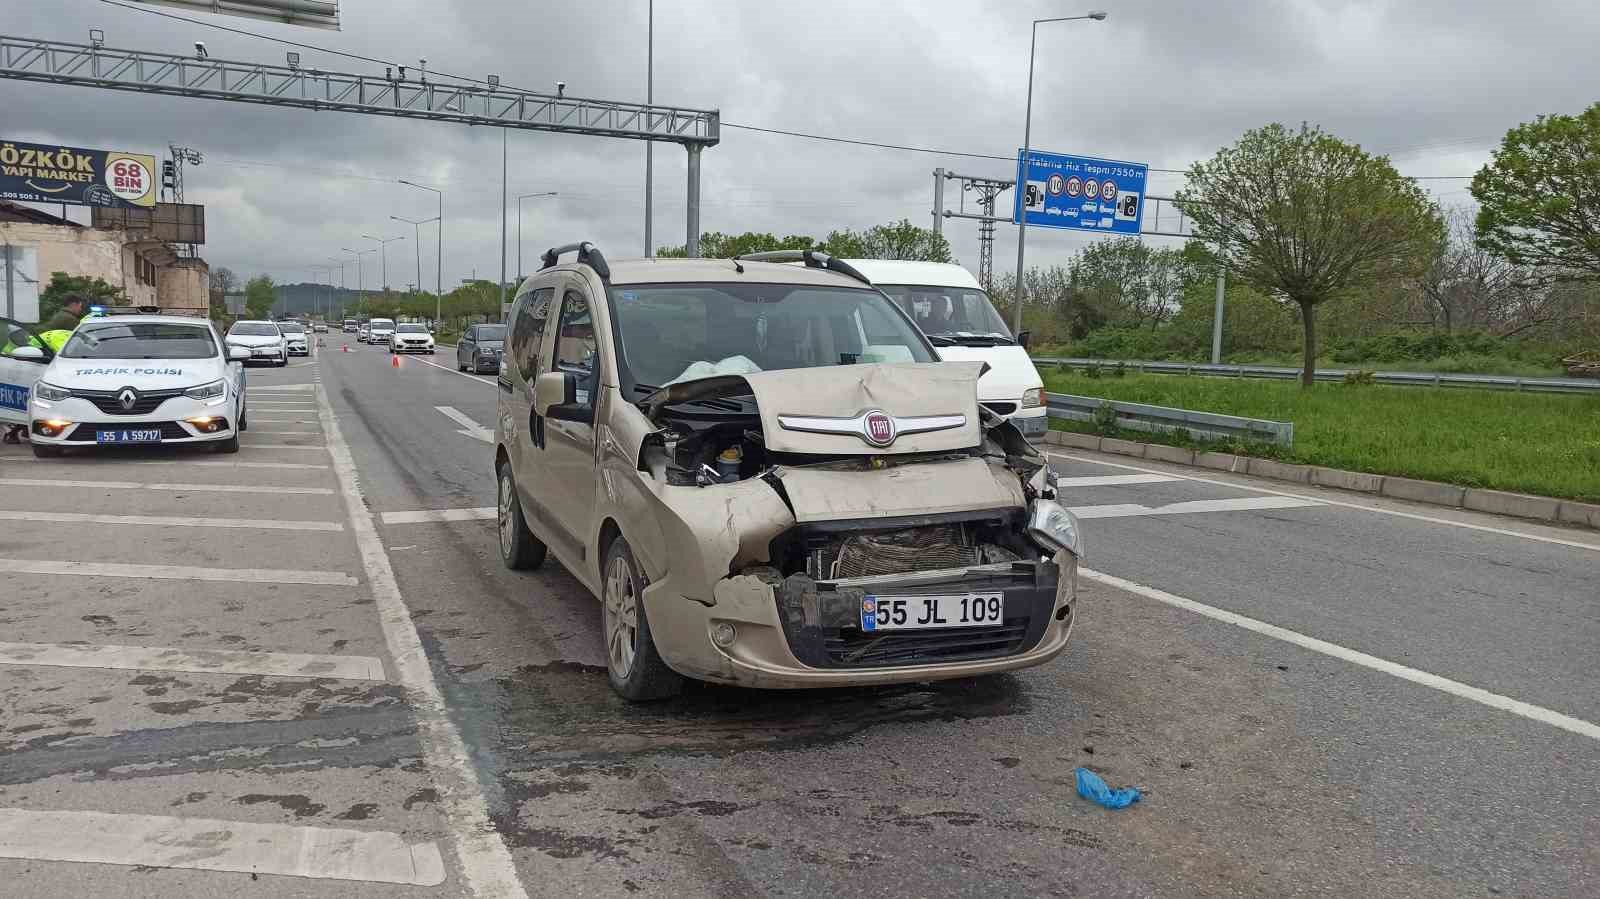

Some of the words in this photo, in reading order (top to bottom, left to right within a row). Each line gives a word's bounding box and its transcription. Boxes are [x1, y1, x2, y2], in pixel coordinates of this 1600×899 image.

[0, 143, 94, 173] ÖZKÖK
[2, 165, 33, 178] YAPI
[36, 167, 96, 183] MARKET
[113, 162, 142, 177] 68
[1135, 171, 1144, 179] m
[114, 176, 142, 188] BİN
[1051, 179, 1063, 191] 110
[1069, 180, 1080, 192] 100
[1086, 183, 1097, 195] 90
[1104, 185, 1114, 196] 85
[871, 419, 889, 436] FIAT
[103, 431, 116, 441] 55
[122, 431, 128, 441] A
[131, 430, 159, 441] 59717
[876, 600, 907, 626] 55
[917, 599, 947, 625] JL
[959, 597, 1000, 623] 109
[865, 615, 875, 624] TR
